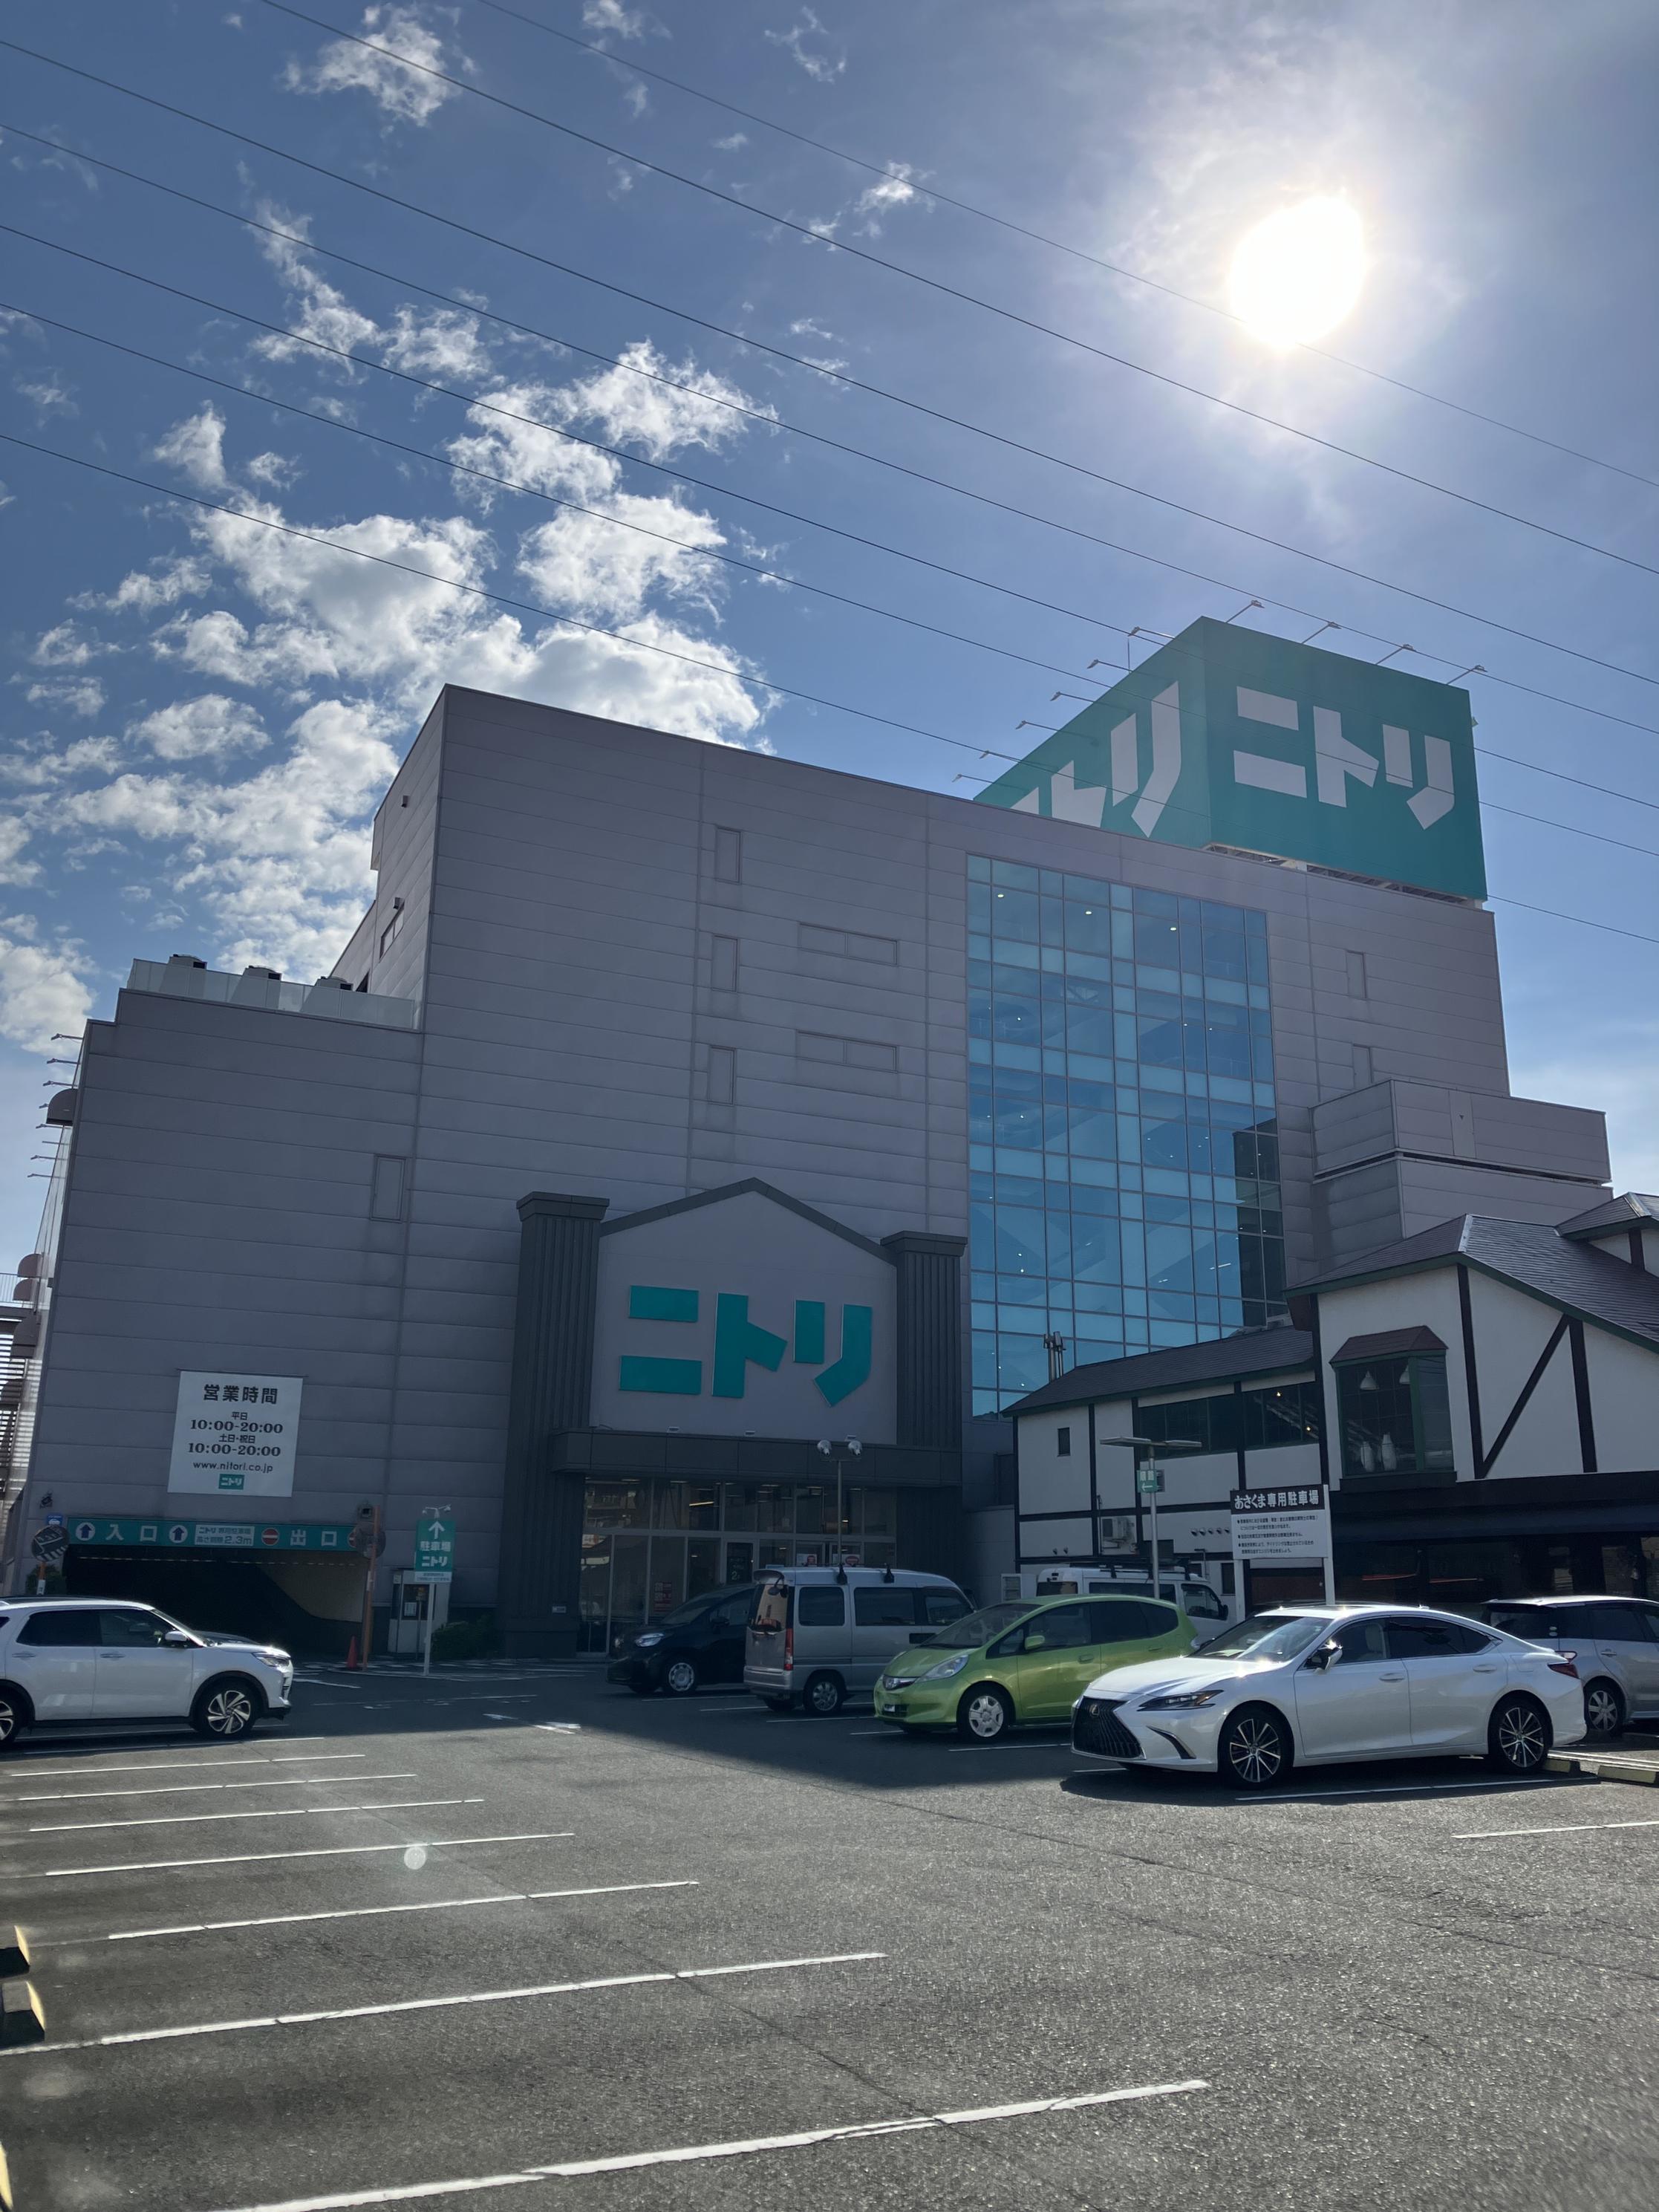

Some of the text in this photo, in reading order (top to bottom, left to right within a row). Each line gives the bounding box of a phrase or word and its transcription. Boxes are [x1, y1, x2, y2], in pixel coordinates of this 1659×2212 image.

[1011, 680, 1181, 838] トリ
[1233, 686, 1455, 830] ニトリ
[619, 1285, 872, 1407] ニトリ
[203, 1384, 278, 1405] 営業時間
[232, 1411, 248, 1420] 平日
[190, 1419, 283, 1434] 10:00-20:00
[188, 1442, 281, 1457] 10:00-20:00
[193, 1461, 273, 1473] www.nitori.co.jp
[221, 1477, 242, 1486] ニトリ
[105, 1524, 157, 1542] 入口
[290, 1529, 337, 1546] 出口
[422, 1556, 448, 1567] ニトリ
